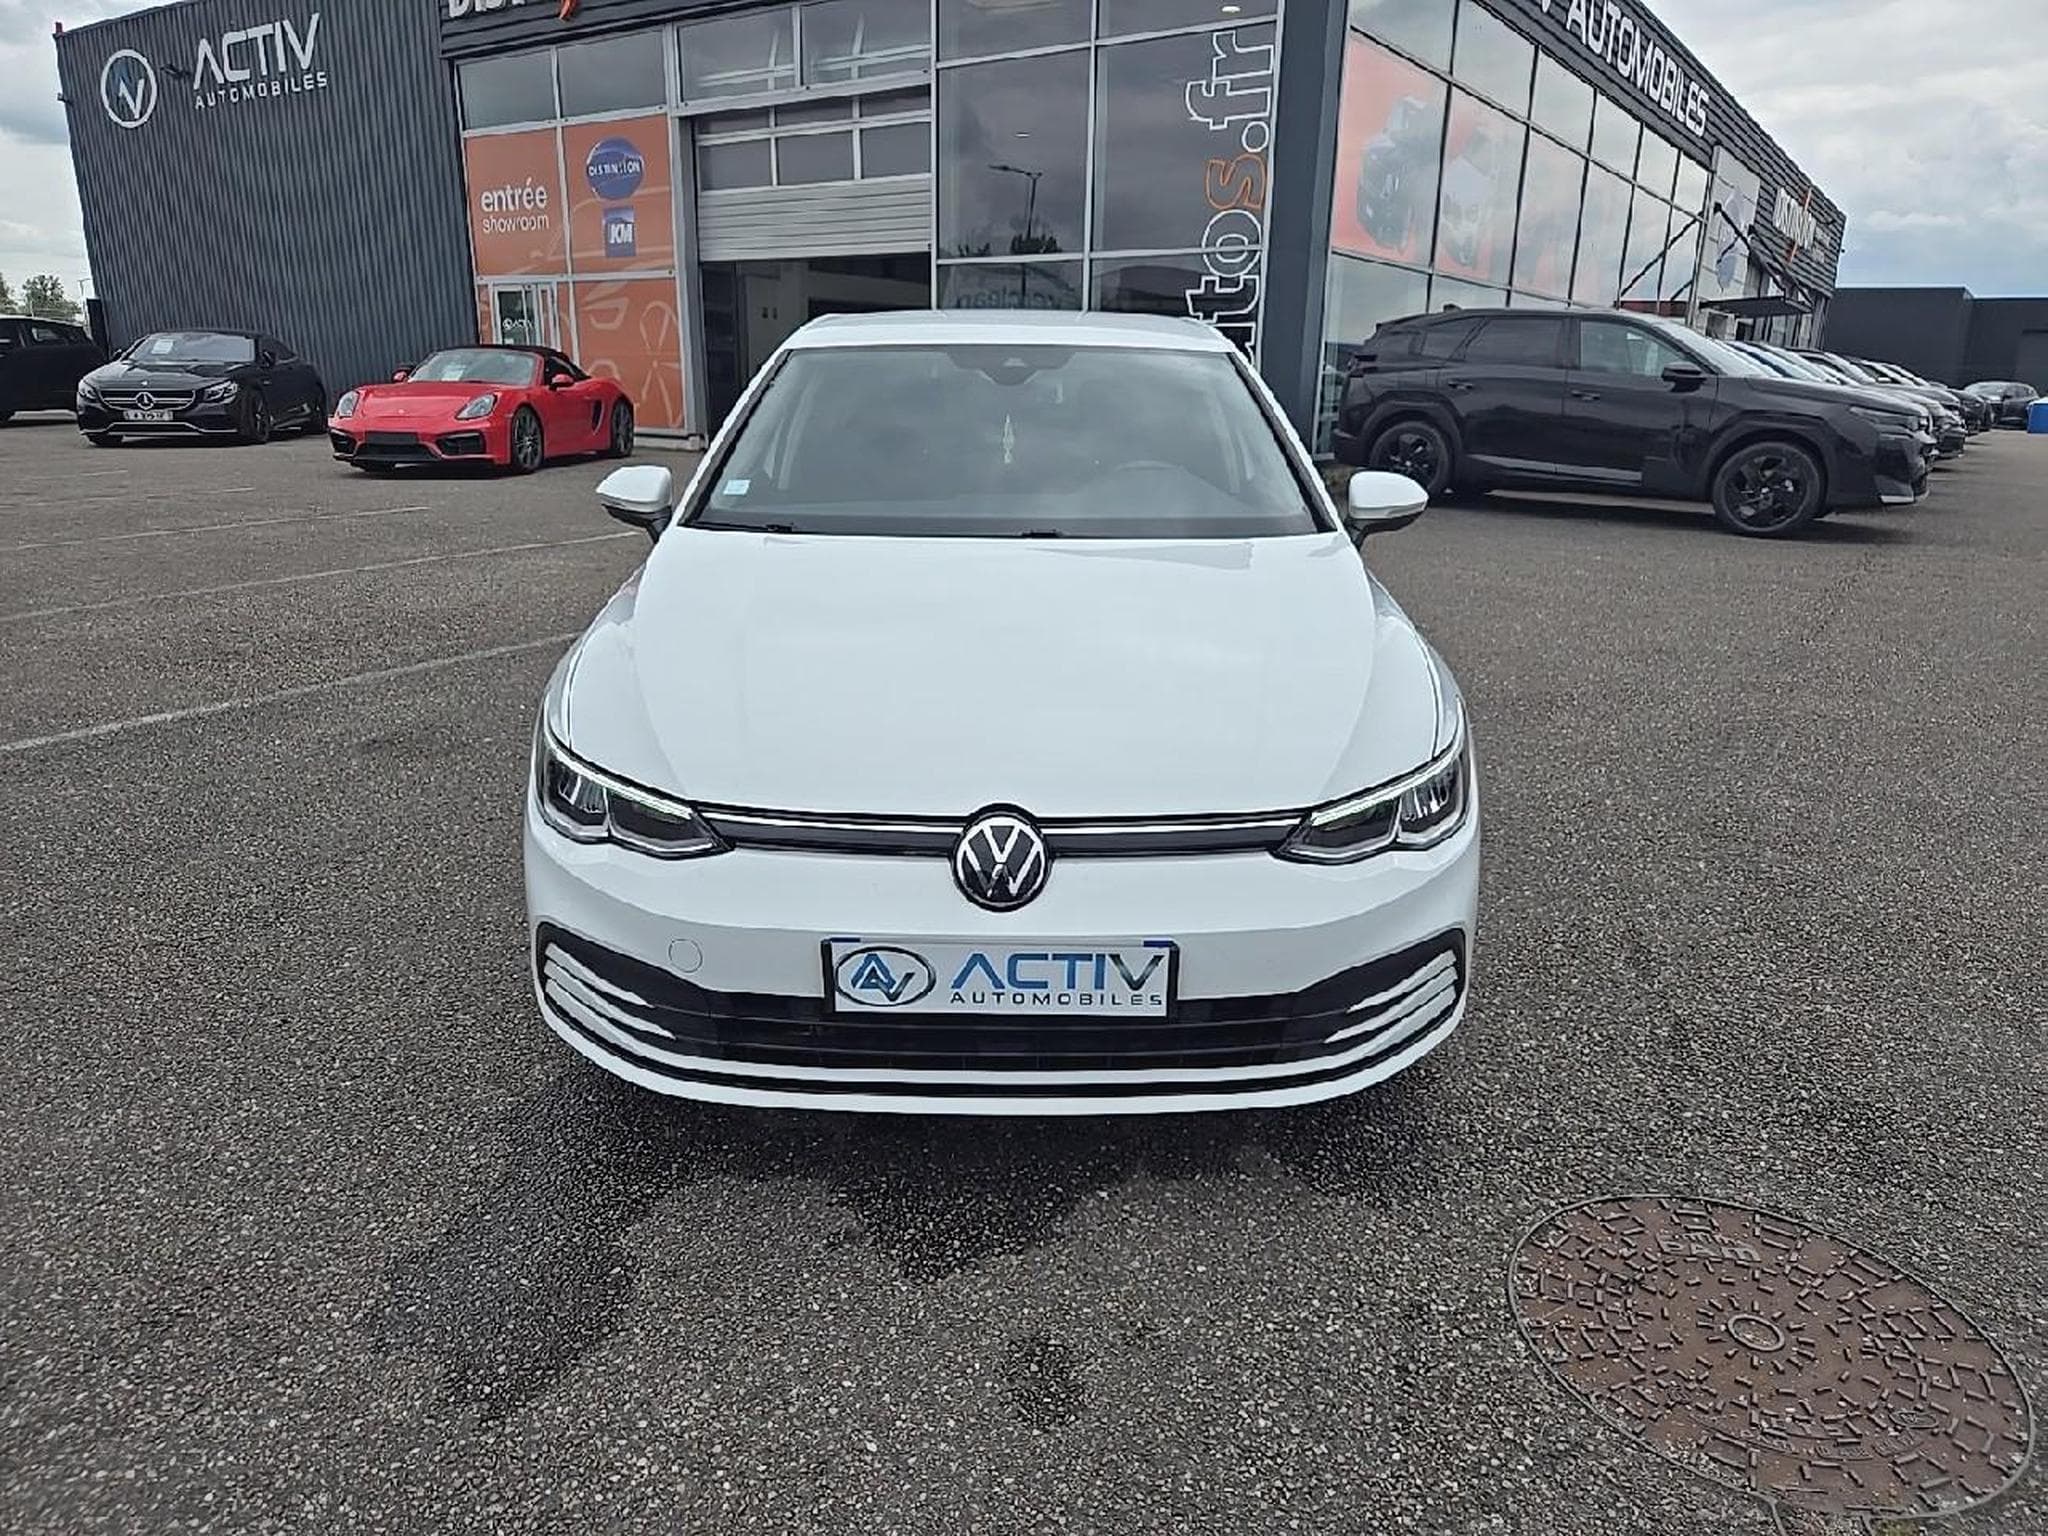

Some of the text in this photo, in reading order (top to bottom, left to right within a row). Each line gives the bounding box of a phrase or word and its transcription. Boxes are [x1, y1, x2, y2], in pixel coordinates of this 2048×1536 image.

[193, 12, 320, 91] ACTIV
[1566, 0, 1709, 137] AUTOMOBILES
[195, 71, 328, 110] AUTOMOBILES
[481, 177, 548, 212] entrée
[482, 214, 550, 233] showroom
[951, 953, 1165, 991] ACTIV
[951, 992, 1163, 1007] AUTOMOBILES
